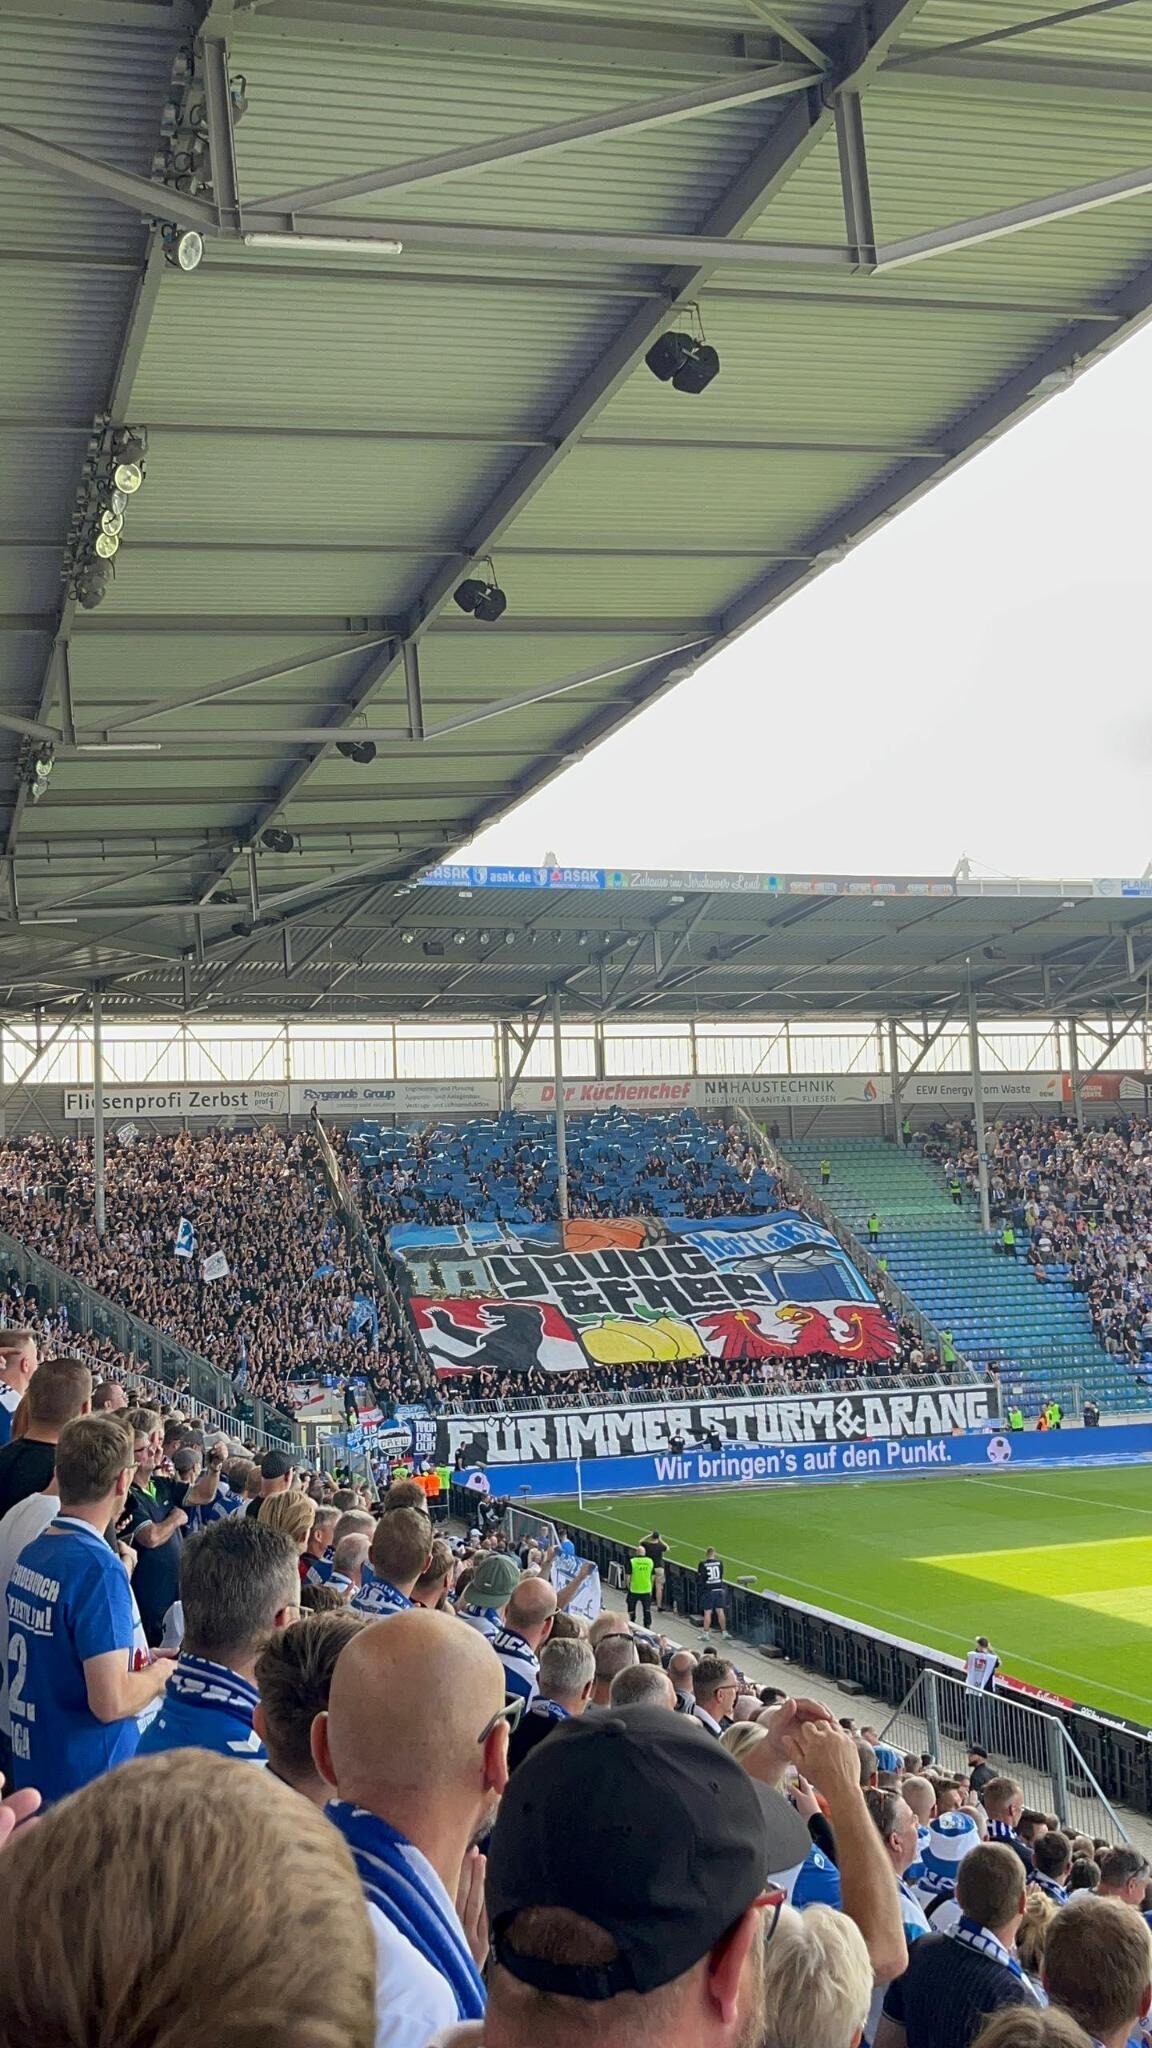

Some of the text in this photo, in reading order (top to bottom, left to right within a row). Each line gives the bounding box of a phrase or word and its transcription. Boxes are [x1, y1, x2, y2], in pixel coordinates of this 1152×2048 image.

[436, 867, 470, 880] ASAK
[490, 868, 531, 883] asak.de
[563, 870, 599, 882] ASAK
[363, 1088, 396, 1100] Group
[581, 1082, 691, 1100] Küchenchef
[916, 1085, 938, 1095] EEW
[940, 1085, 974, 1097] Energy
[1001, 1084, 1031, 1094] Waste
[188, 1090, 249, 1108] Zerbst
[802, 1095, 837, 1103] FLIESEN
[448, 1416, 550, 1463] FÜR
[554, 1408, 696, 1459] IMMER
[654, 1456, 692, 1480] Wir
[803, 1444, 838, 1471] auf
[842, 1444, 881, 1467] den
[887, 1440, 952, 1466] Punkt.
[706, 1565, 721, 1581] 30
[7, 1632, 36, 1722] 2.
[10, 1720, 31, 1760] IGA
